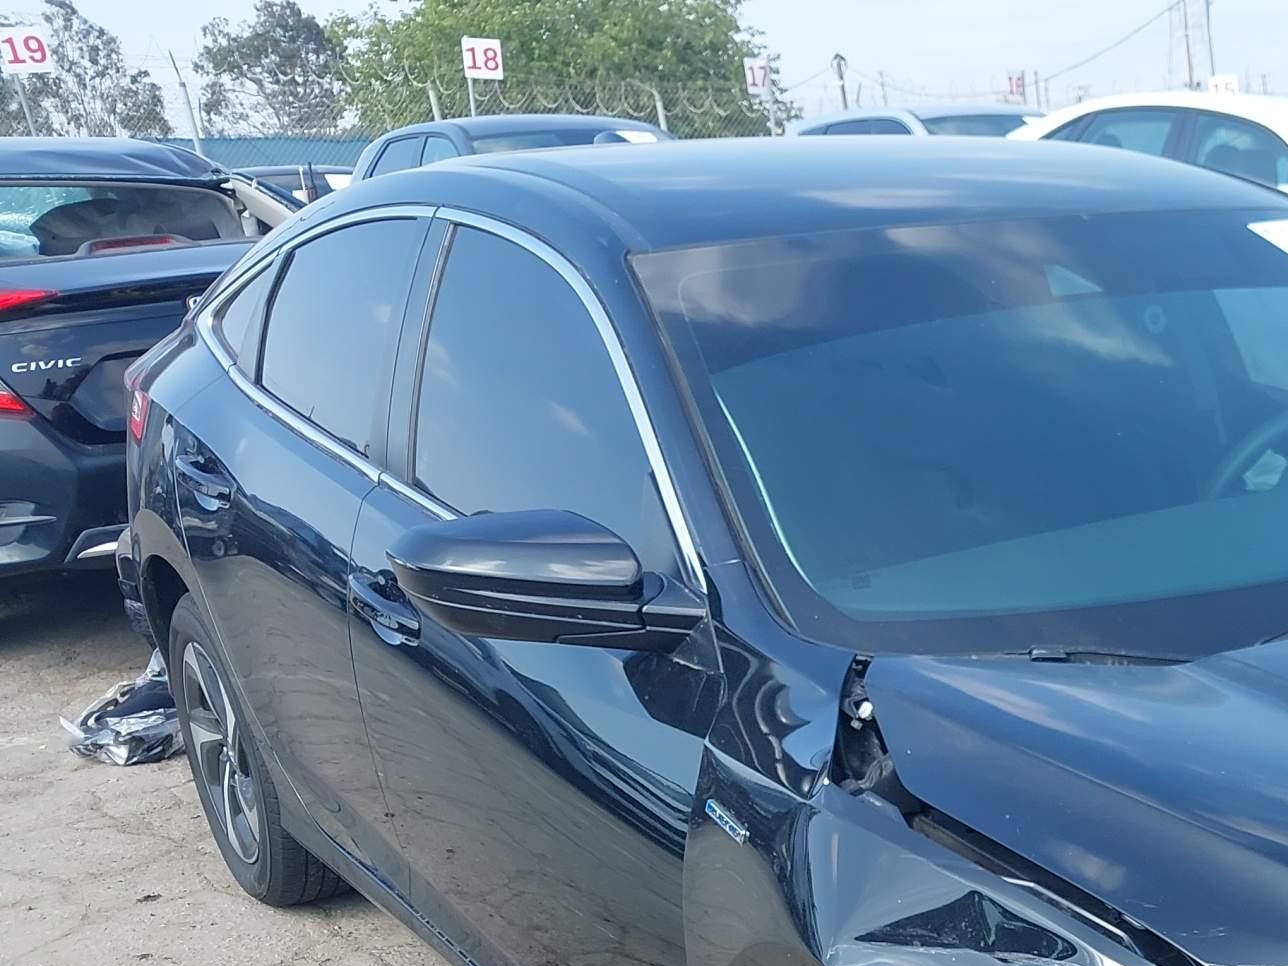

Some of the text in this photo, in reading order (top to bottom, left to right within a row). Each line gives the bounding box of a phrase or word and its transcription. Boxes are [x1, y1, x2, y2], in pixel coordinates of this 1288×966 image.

[1, 36, 47, 64] 19
[465, 46, 499, 71] 18
[748, 66, 768, 88] 17
[11, 357, 82, 373] CIVIC
